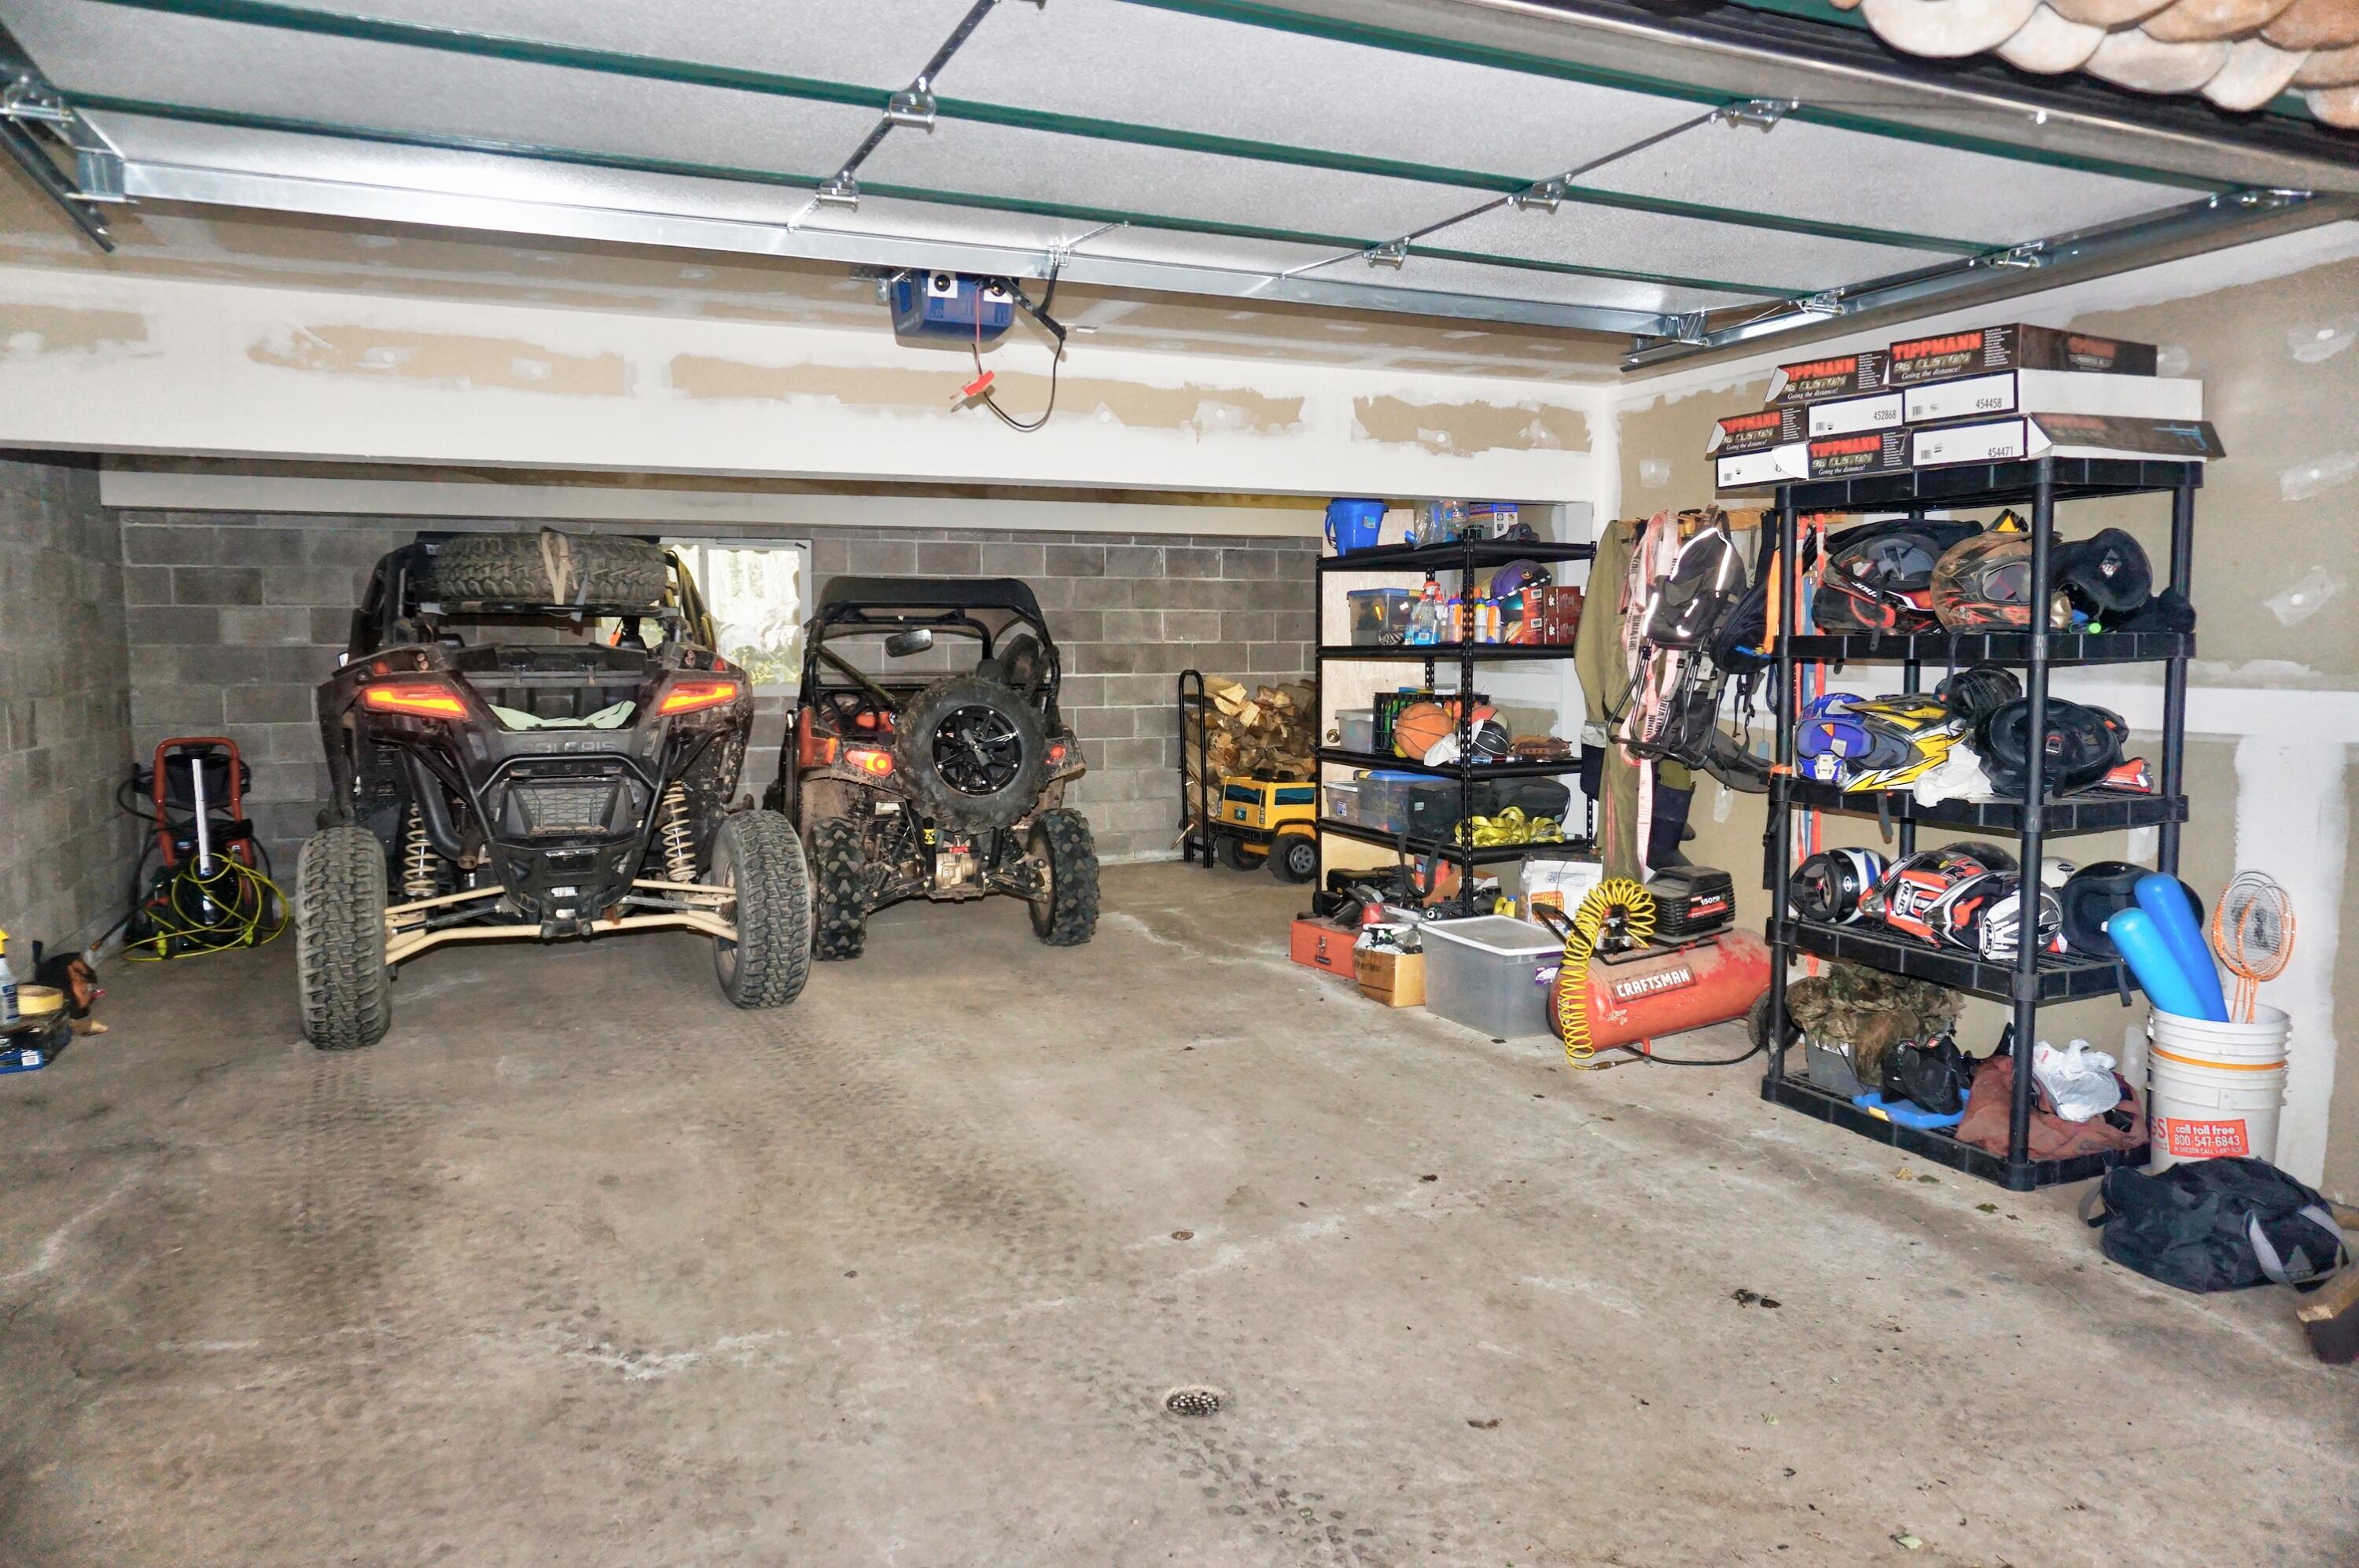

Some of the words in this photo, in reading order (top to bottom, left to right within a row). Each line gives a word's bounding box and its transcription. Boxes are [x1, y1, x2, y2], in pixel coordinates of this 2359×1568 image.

[1892, 333, 1982, 360] TIPPMANN
[1893, 361, 1912, 373] 98
[1915, 352, 1971, 370] CUSTOM
[1933, 365, 1961, 375] distance!
[1799, 376, 1848, 391] CUSTOM
[1787, 391, 1804, 399] Going
[1813, 388, 1838, 396] distance!
[1975, 397, 2002, 409] 454458
[1873, 410, 1897, 421] 452868
[1735, 429, 1774, 442] CUSTOM
[1747, 439, 1768, 447] distance!
[1810, 435, 1880, 458] TIPPMANN
[1988, 446, 2014, 458] 454471
[1812, 458, 1827, 469] 98
[1829, 453, 1874, 467] CUSTOM
[1700, 897, 1713, 906] 150
[1616, 969, 1691, 998] CRAFTSMAN
[2176, 1124, 2191, 1134] call
[2193, 1124, 2210, 1135] toll
[2212, 1125, 2235, 1135] free
[2174, 1135, 2240, 1147] 800-547-6843
